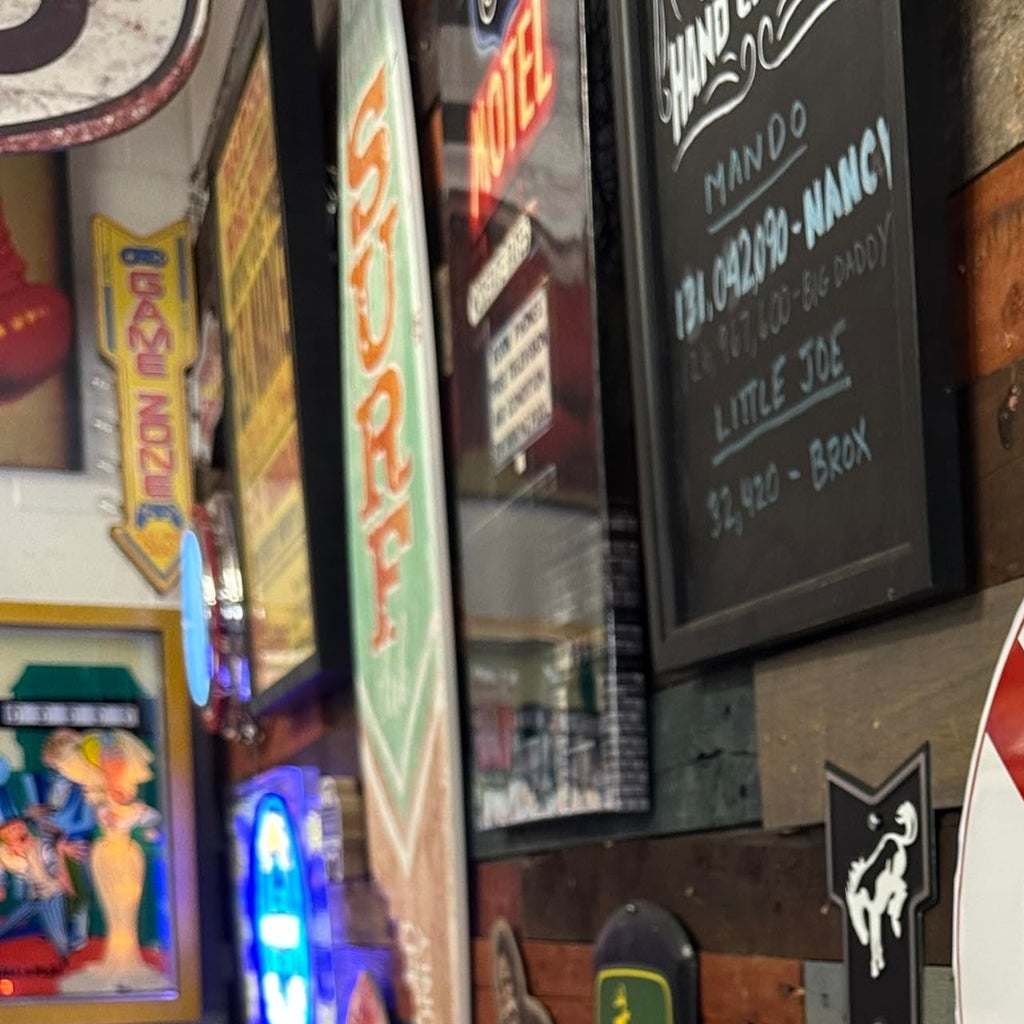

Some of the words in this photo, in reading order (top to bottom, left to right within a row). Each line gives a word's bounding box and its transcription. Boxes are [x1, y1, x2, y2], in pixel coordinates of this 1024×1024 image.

[470, 0, 553, 210] MOTEL
[668, 0, 731, 146] HAND
[704, 100, 807, 214] MANDO
[128, 270, 176, 377] GAME
[347, 64, 412, 652] SURF
[713, 354, 788, 443] LITTLE
[798, 318, 846, 394] JOE
[137, 394, 176, 498] ZONE
